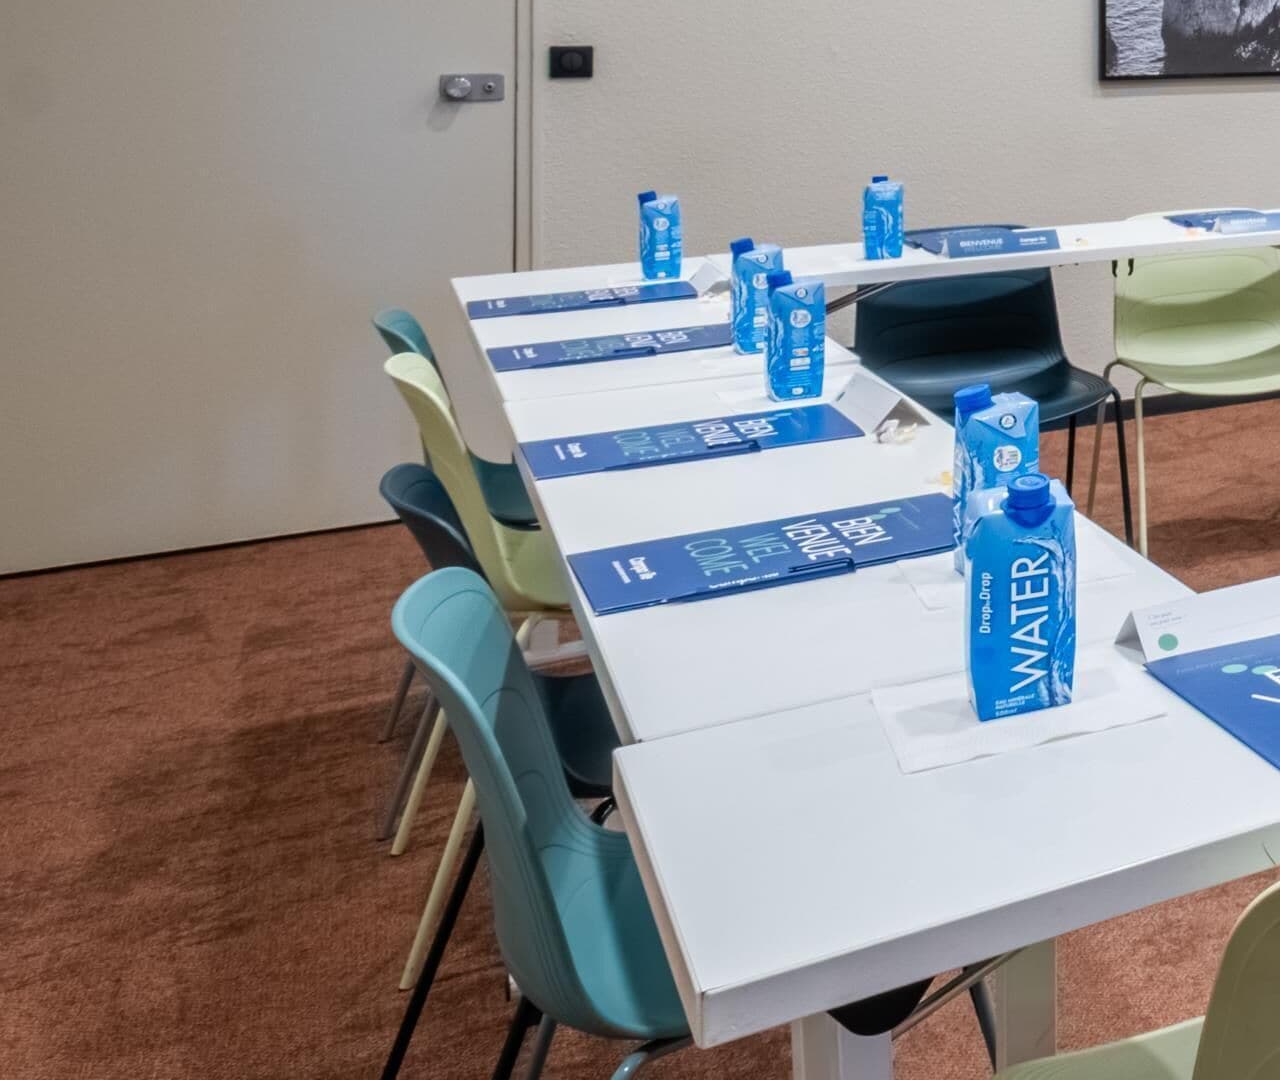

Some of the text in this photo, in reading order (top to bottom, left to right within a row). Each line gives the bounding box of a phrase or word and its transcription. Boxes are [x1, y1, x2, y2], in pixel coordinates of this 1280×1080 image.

[738, 532, 793, 563] WEL
[781, 518, 852, 561] VENUE
[831, 516, 894, 546] BIEN
[684, 537, 749, 577] COME
[979, 572, 994, 634] Drop Drop
[1009, 550, 1049, 694] WATER
